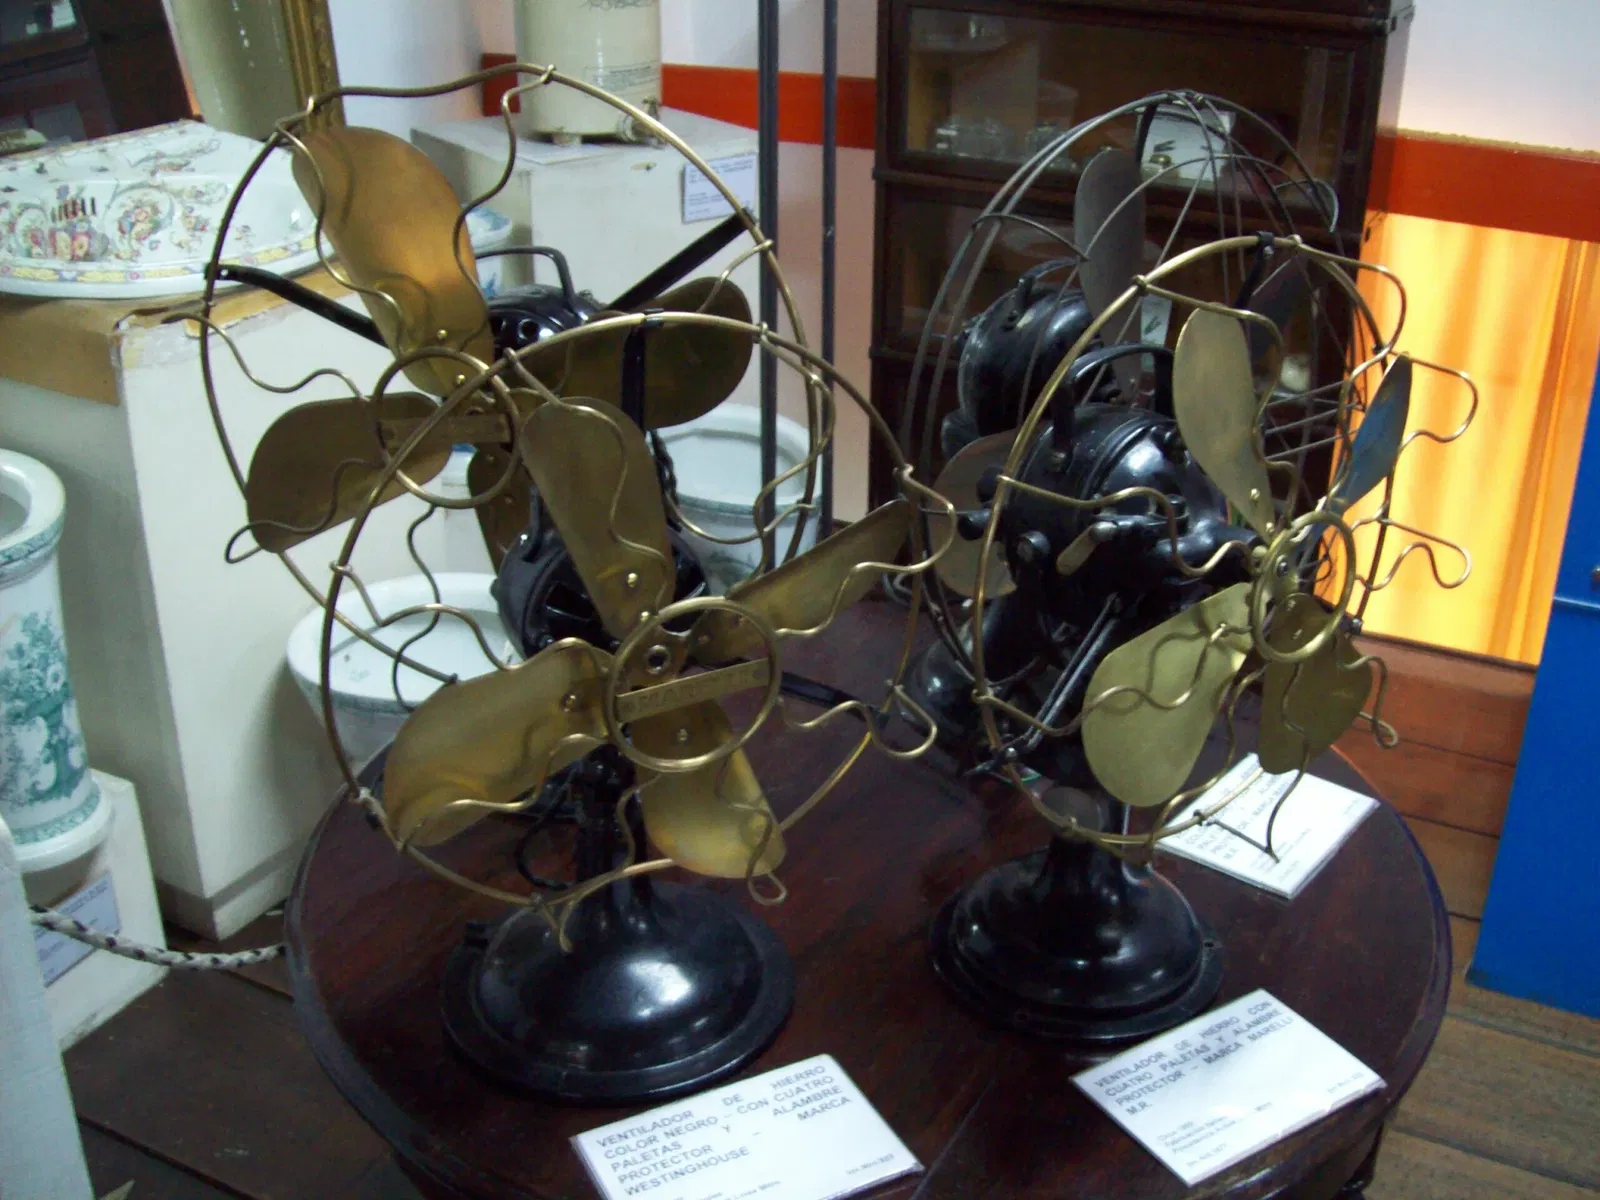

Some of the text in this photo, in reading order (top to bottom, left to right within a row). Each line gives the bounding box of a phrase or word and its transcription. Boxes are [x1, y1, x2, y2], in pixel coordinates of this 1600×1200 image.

[1094, 1050, 1167, 1088] VENTILADOR
[1198, 1014, 1242, 1039] HIERRO
[1246, 999, 1273, 1016] CON
[1104, 1007, 1282, 1098] CUATRO PALETAS Y ALAMBRE
[1116, 1068, 1186, 1107] PROTECTOR
[1202, 1040, 1244, 1065] MARCA
[597, 1064, 827, 1148] VENTILADOR DE HIERRO
[603, 1134, 661, 1160] COLOR
[664, 1114, 720, 1140] NEGRO
[736, 1097, 770, 1115] CON
[773, 1074, 836, 1102] CUATRO
[611, 1139, 683, 1172] PALETAS
[771, 1084, 844, 1117] ALAMBRE
[617, 1143, 714, 1184] PROTECTOR
[796, 1094, 853, 1121] MARCA
[624, 1144, 751, 1196] WESTINGHOUSE
